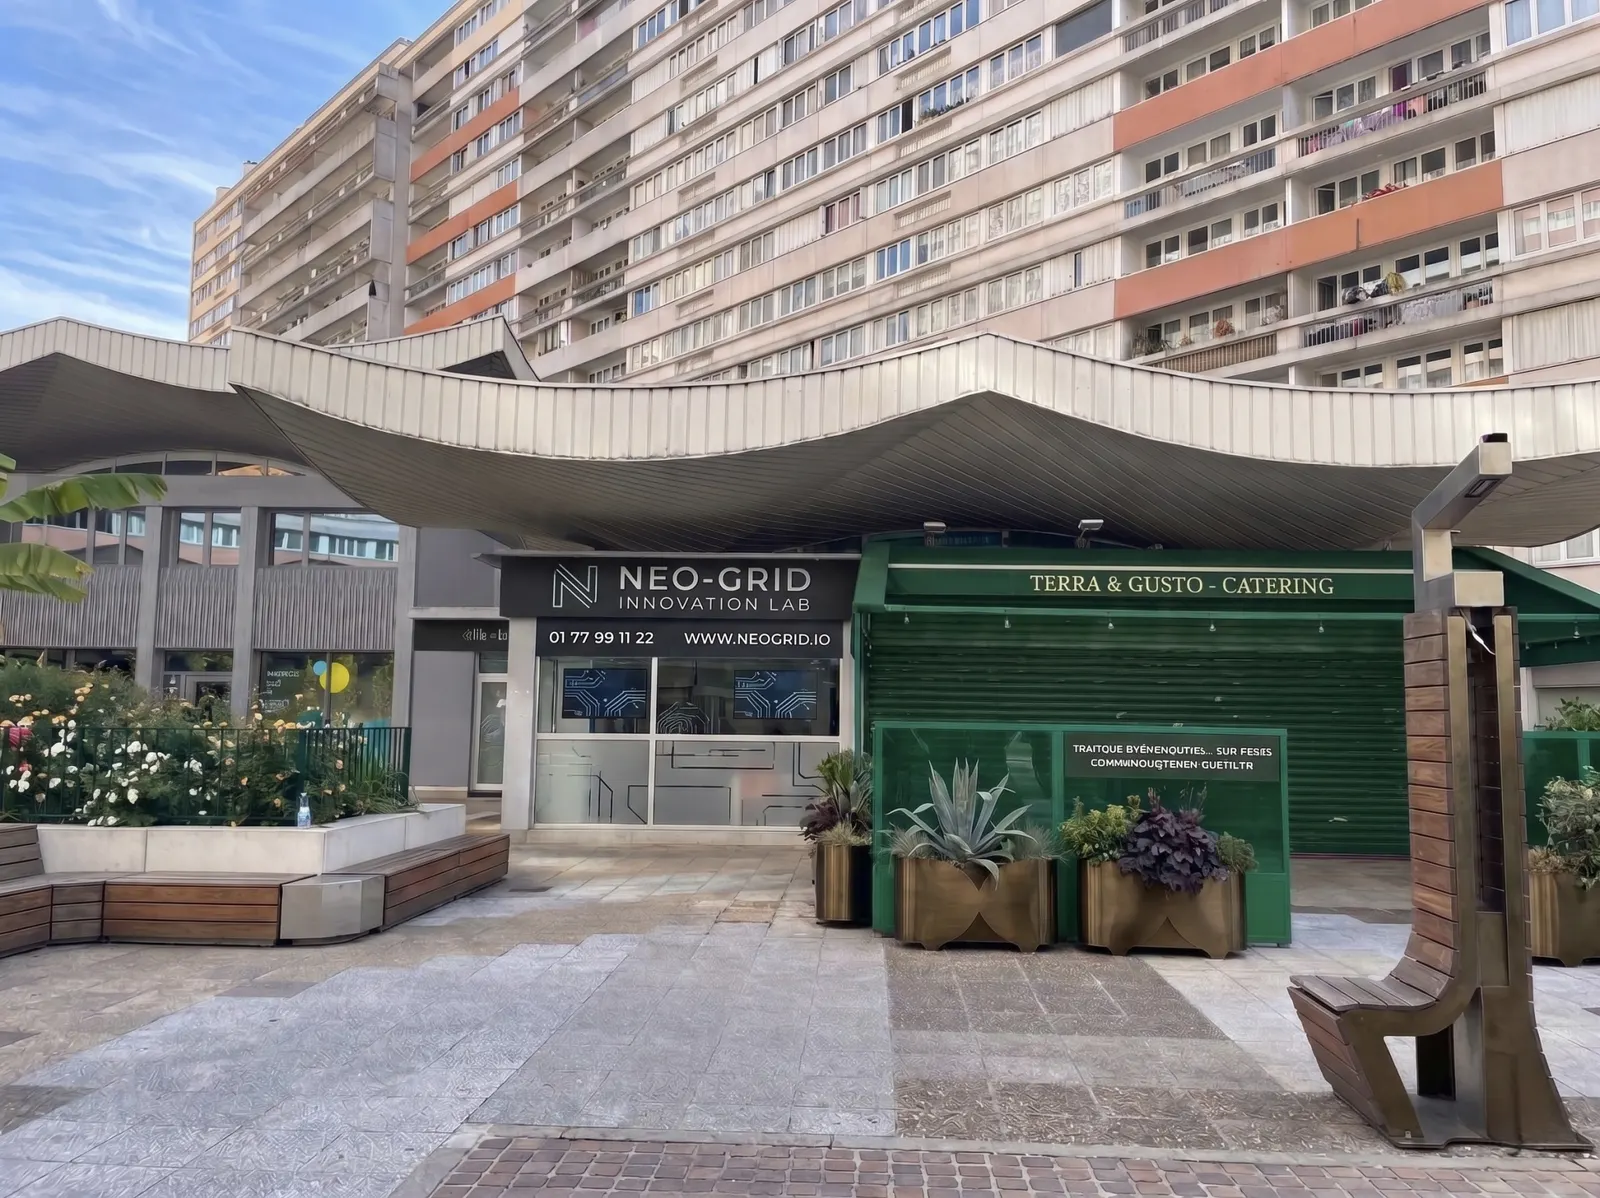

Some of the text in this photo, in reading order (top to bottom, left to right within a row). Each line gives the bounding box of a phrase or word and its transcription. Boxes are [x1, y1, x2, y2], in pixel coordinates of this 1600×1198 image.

[619, 566, 811, 592] NEO-GRID
[1030, 574, 1101, 592] TERRA
[1107, 575, 1122, 592] &
[1128, 576, 1203, 593] GUSTO
[1222, 576, 1334, 595] CATERING
[619, 596, 810, 612] INNOVATION LAB
[549, 631, 654, 645] 01 77 99 11 22
[684, 632, 831, 646] WWW.NEOGRID.IO
[1216, 747, 1238, 756] SUR
